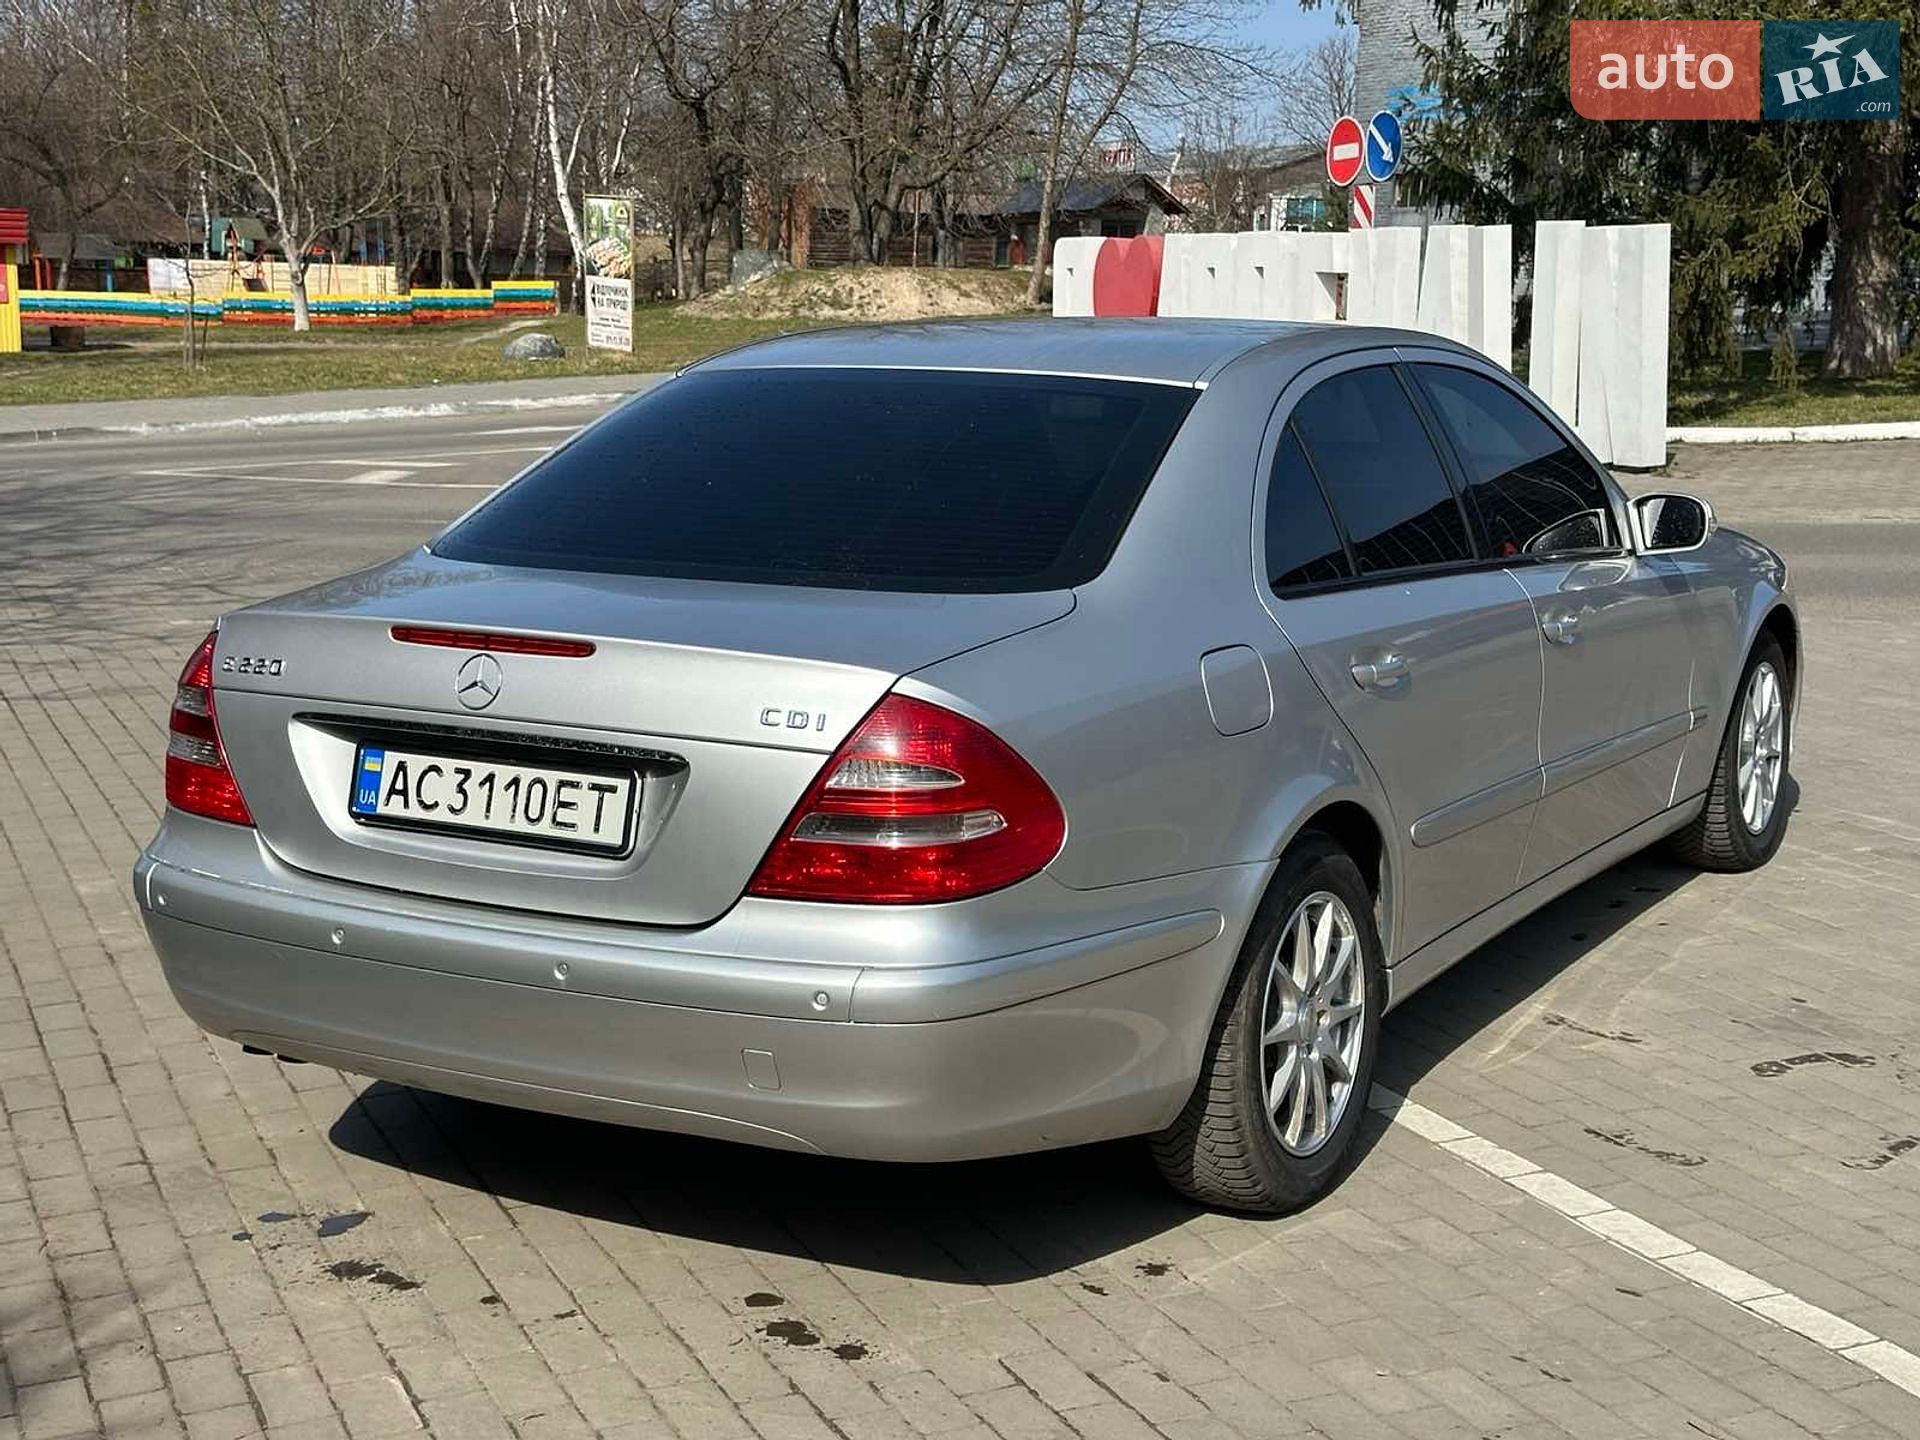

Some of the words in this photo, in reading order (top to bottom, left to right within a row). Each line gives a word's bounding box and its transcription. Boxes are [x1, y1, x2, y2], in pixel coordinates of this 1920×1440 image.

[760, 707, 826, 731] CDI
[359, 789, 377, 806] UA
[383, 760, 618, 834] AC3110ET
